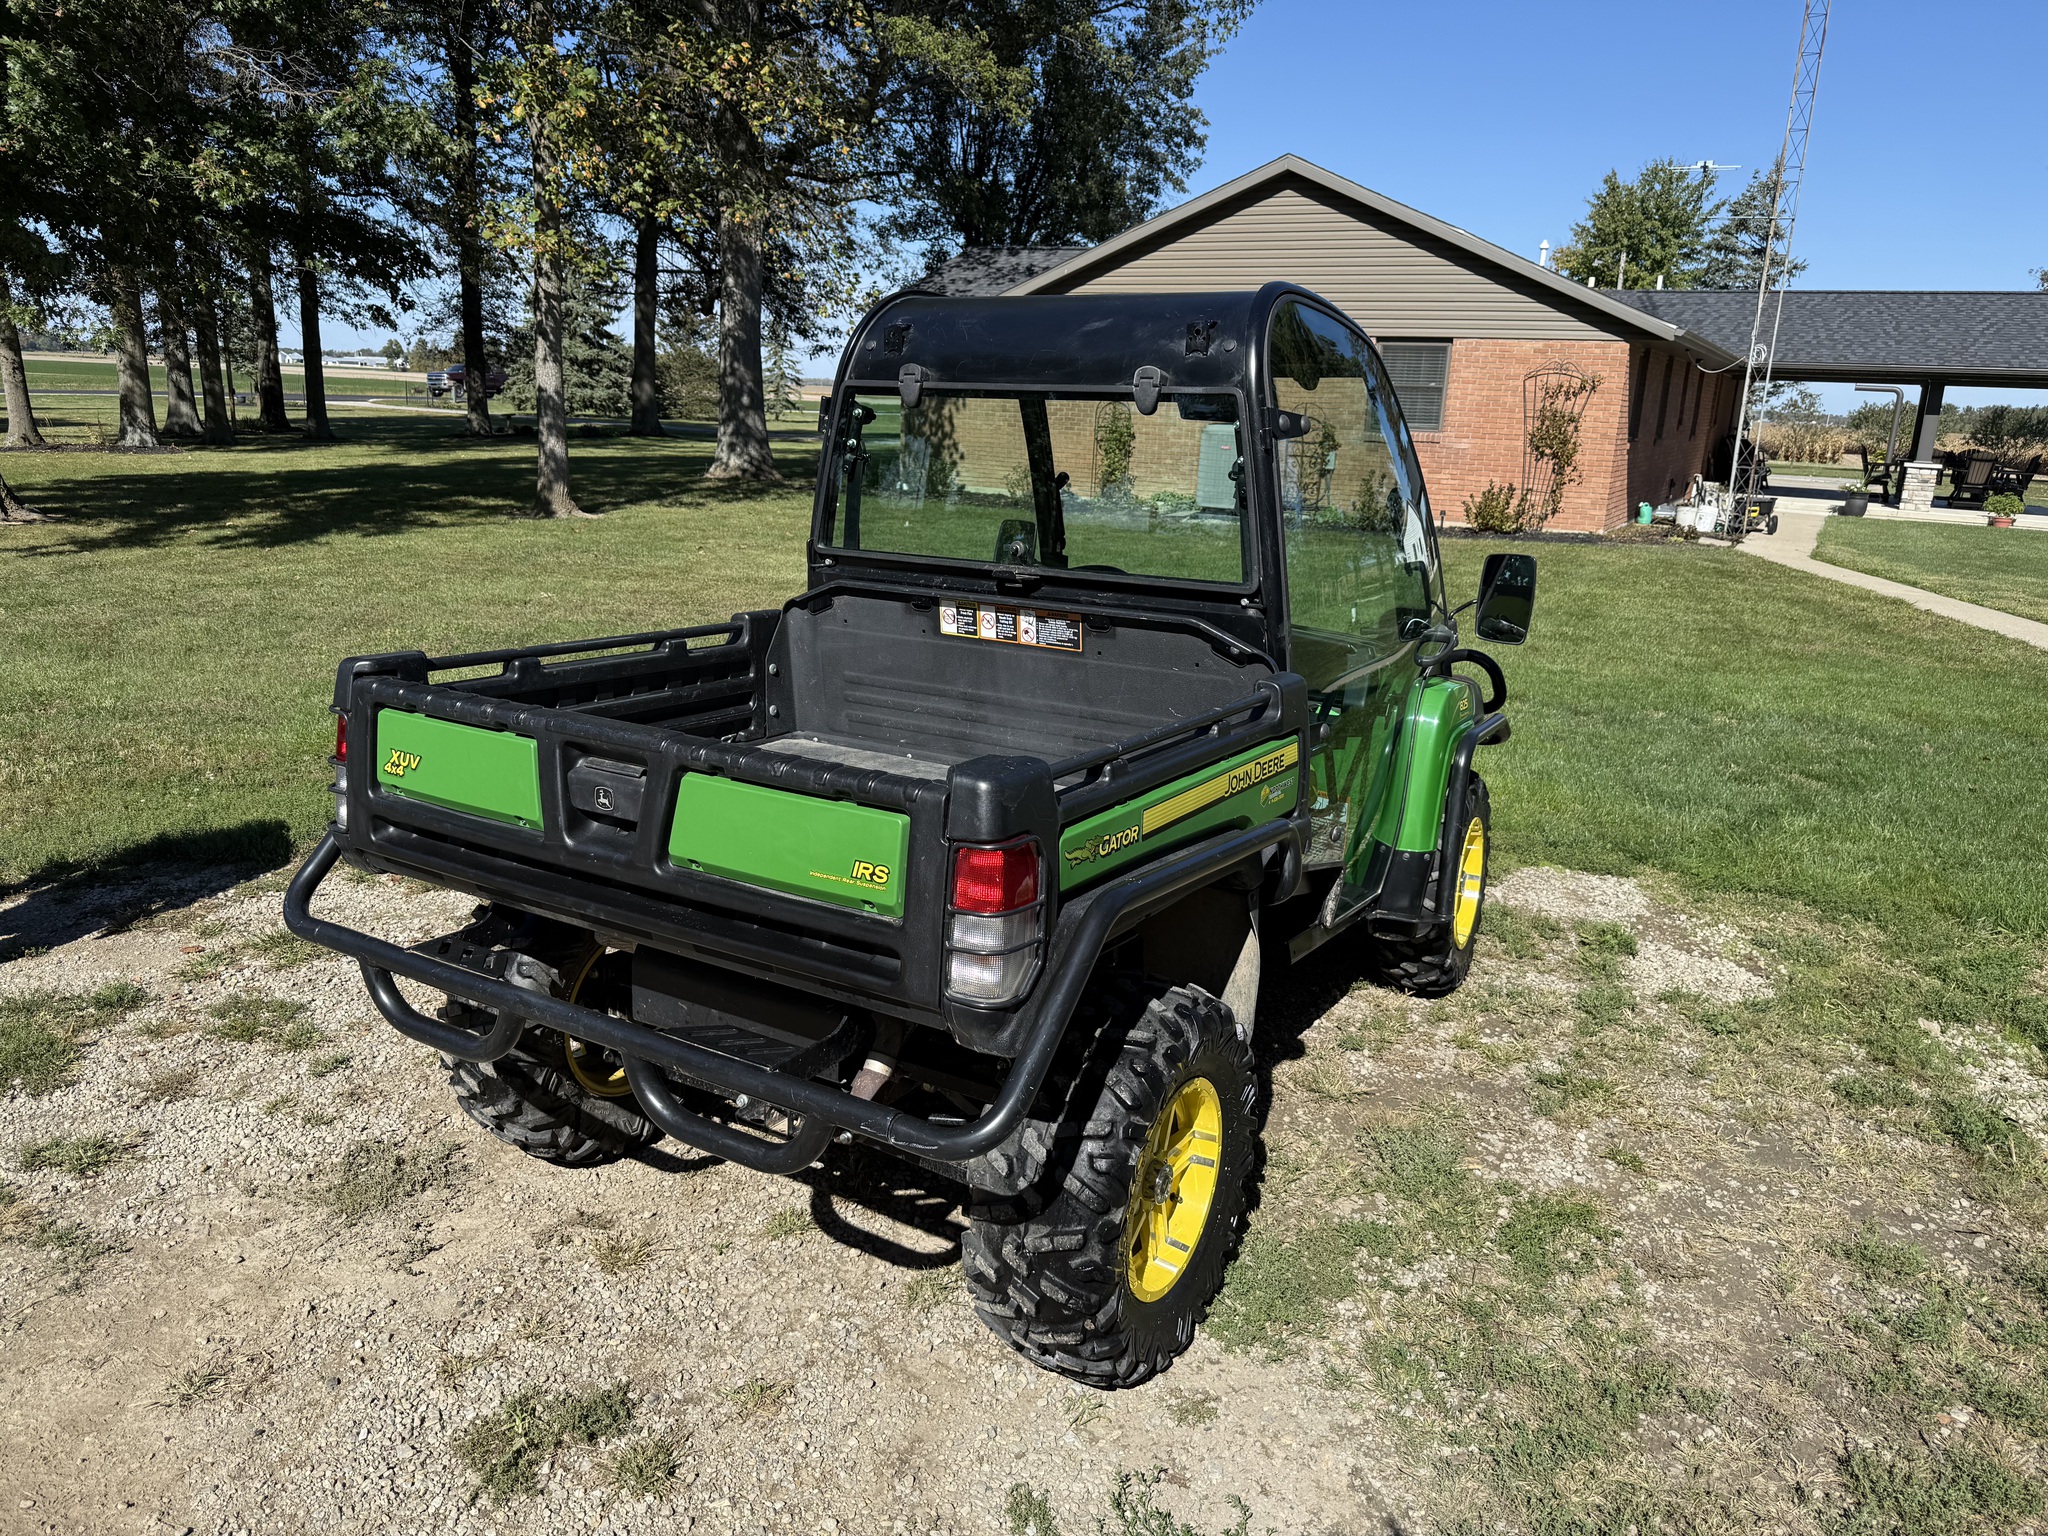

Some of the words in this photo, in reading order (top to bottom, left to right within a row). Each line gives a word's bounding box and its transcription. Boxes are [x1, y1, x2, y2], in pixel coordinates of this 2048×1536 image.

[383, 762, 405, 777] 4x4
[390, 748, 421, 770] XUV
[1225, 767, 1252, 796] JOHN
[1254, 753, 1286, 780] DEERE
[1099, 824, 1139, 858] GATOR
[809, 870, 841, 882] Independent
[842, 877, 855, 885] Rear
[856, 880, 887, 892] Suspension
[851, 859, 890, 884] IRS
